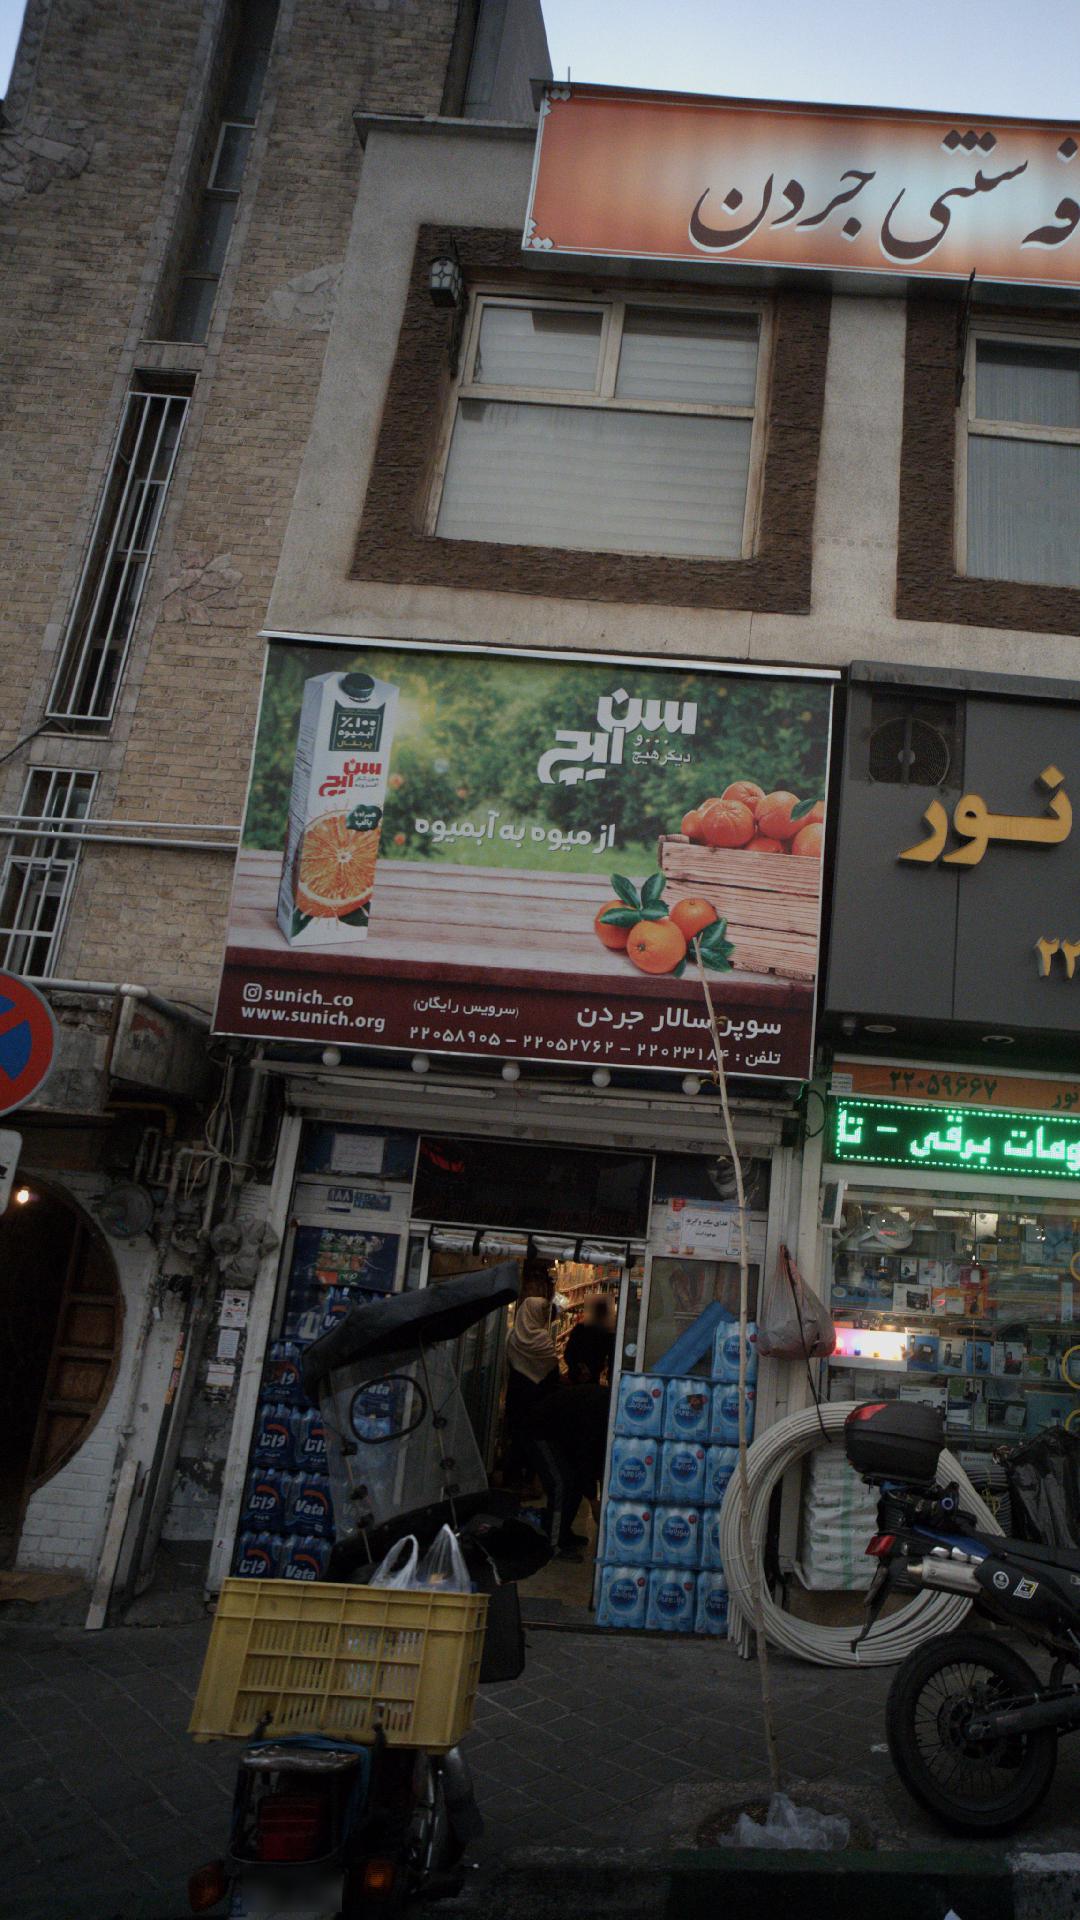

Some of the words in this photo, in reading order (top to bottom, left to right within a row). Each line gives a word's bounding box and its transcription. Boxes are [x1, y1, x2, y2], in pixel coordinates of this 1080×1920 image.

[880, 130, 1028, 264] سنتی
[688, 169, 877, 253] جردن
[596, 687, 698, 734] سن
[337, 740, 373, 750] پرتقال
[338, 727, 375, 739] آبمیوه
[537, 727, 625, 785] ایچ
[414, 810, 499, 845] آبمیوه
[899, 764, 1073, 867] نور
[501, 822, 527, 848] به
[531, 825, 592, 851] میوه
[592, 823, 616, 853] از
[265, 988, 354, 1006] sunich_co
[241, 1007, 386, 1032] www.sunich.org
[577, 1005, 644, 1030] جردن
[652, 1007, 713, 1031] سالار
[719, 1017, 782, 1041] سوپر
[410, 1026, 501, 1046] ۲۲۰۵۸۹۰۵
[523, 1035, 614, 1054] ۲۲۰۵۲۷۶۲
[745, 1051, 782, 1066] تلفن
[910, 1114, 992, 1164] برقی
[295, 1499, 325, 1516] Vata
[285, 1564, 316, 1580] Vata
